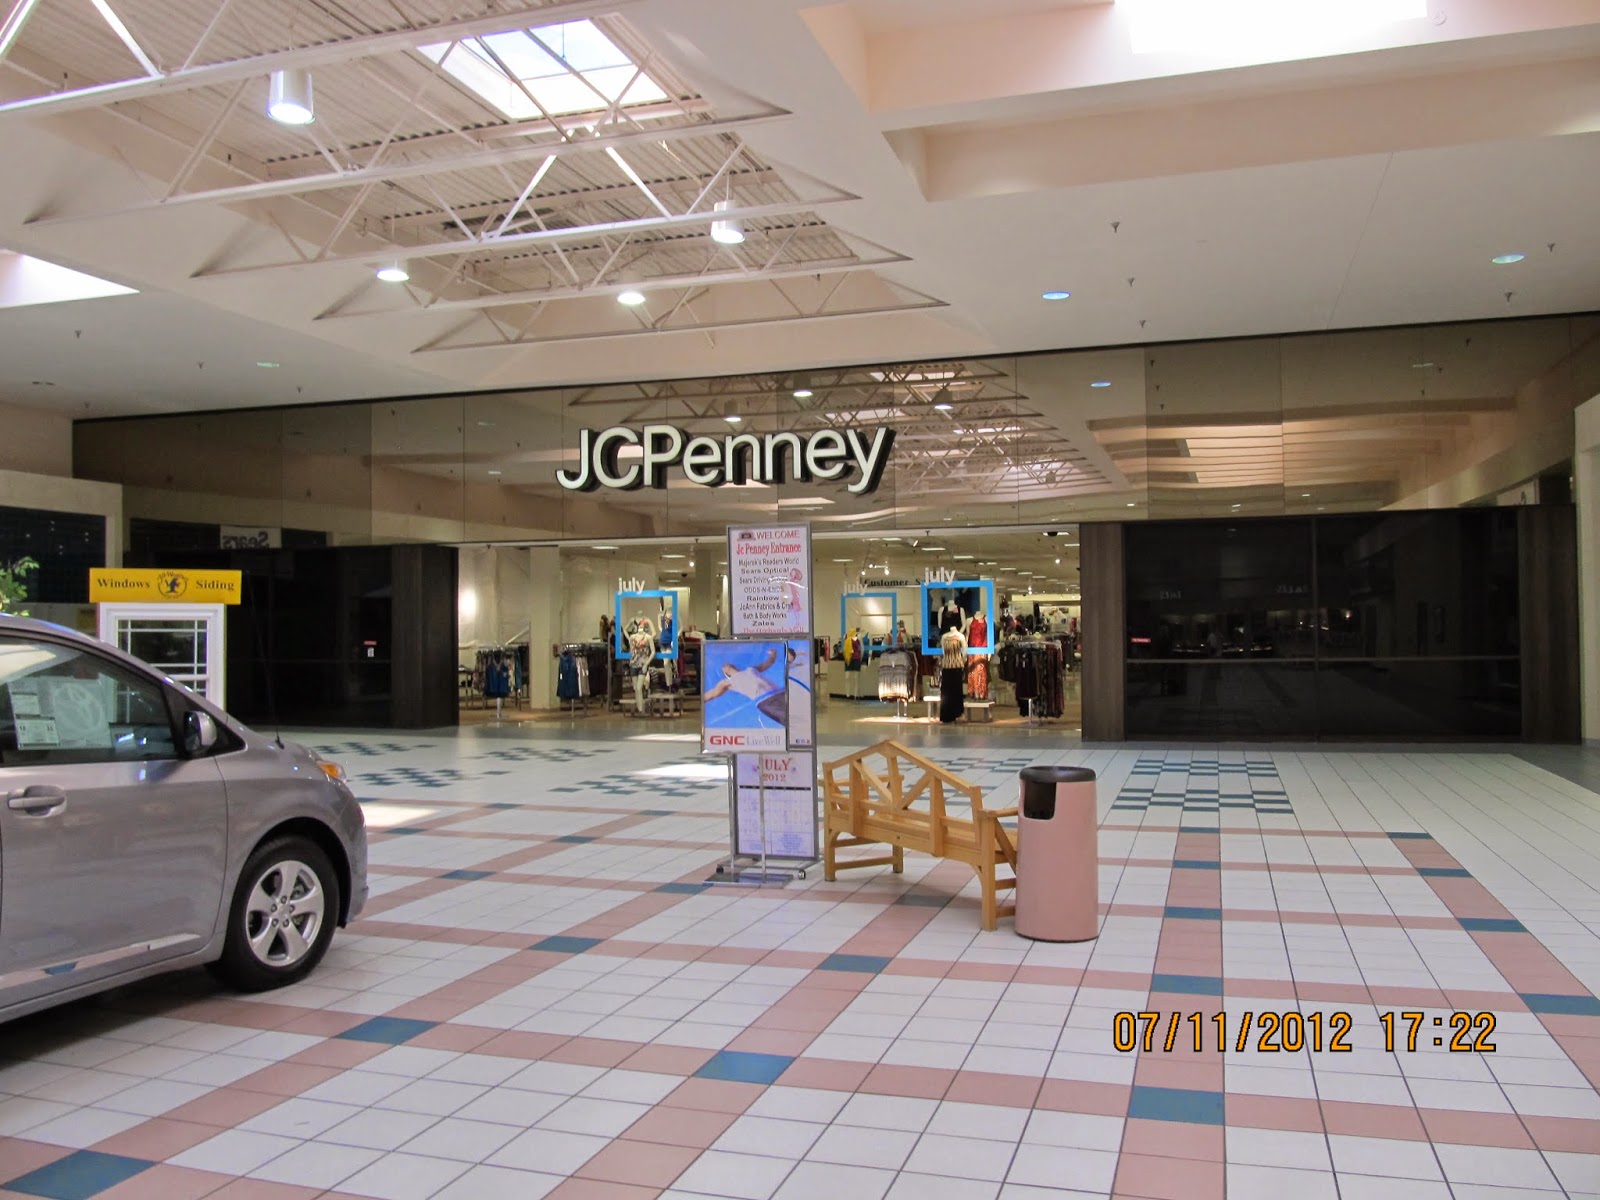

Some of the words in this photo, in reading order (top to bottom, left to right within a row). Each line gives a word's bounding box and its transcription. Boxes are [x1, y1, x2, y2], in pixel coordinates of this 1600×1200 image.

[555, 424, 896, 495] JCPenney
[756, 530, 800, 540] WELCOME
[745, 543, 770, 556] Penney
[770, 542, 801, 554] Entrance
[783, 557, 800, 565] World
[763, 567, 790, 575] Optical
[740, 576, 753, 585] Sears
[754, 576, 770, 585] Driving
[924, 567, 955, 586] july
[97, 578, 150, 588] Windows
[195, 579, 234, 591] Siding
[617, 577, 646, 596] july
[864, 578, 908, 587] Customer
[843, 581, 868, 596] july
[756, 602, 776, 611] Fabrics
[743, 612, 754, 620] Bath
[759, 612, 772, 621] Body
[772, 611, 788, 619] Works
[709, 735, 745, 746] GNC
[757, 757, 792, 772] ULY
[762, 773, 786, 781] 2012
